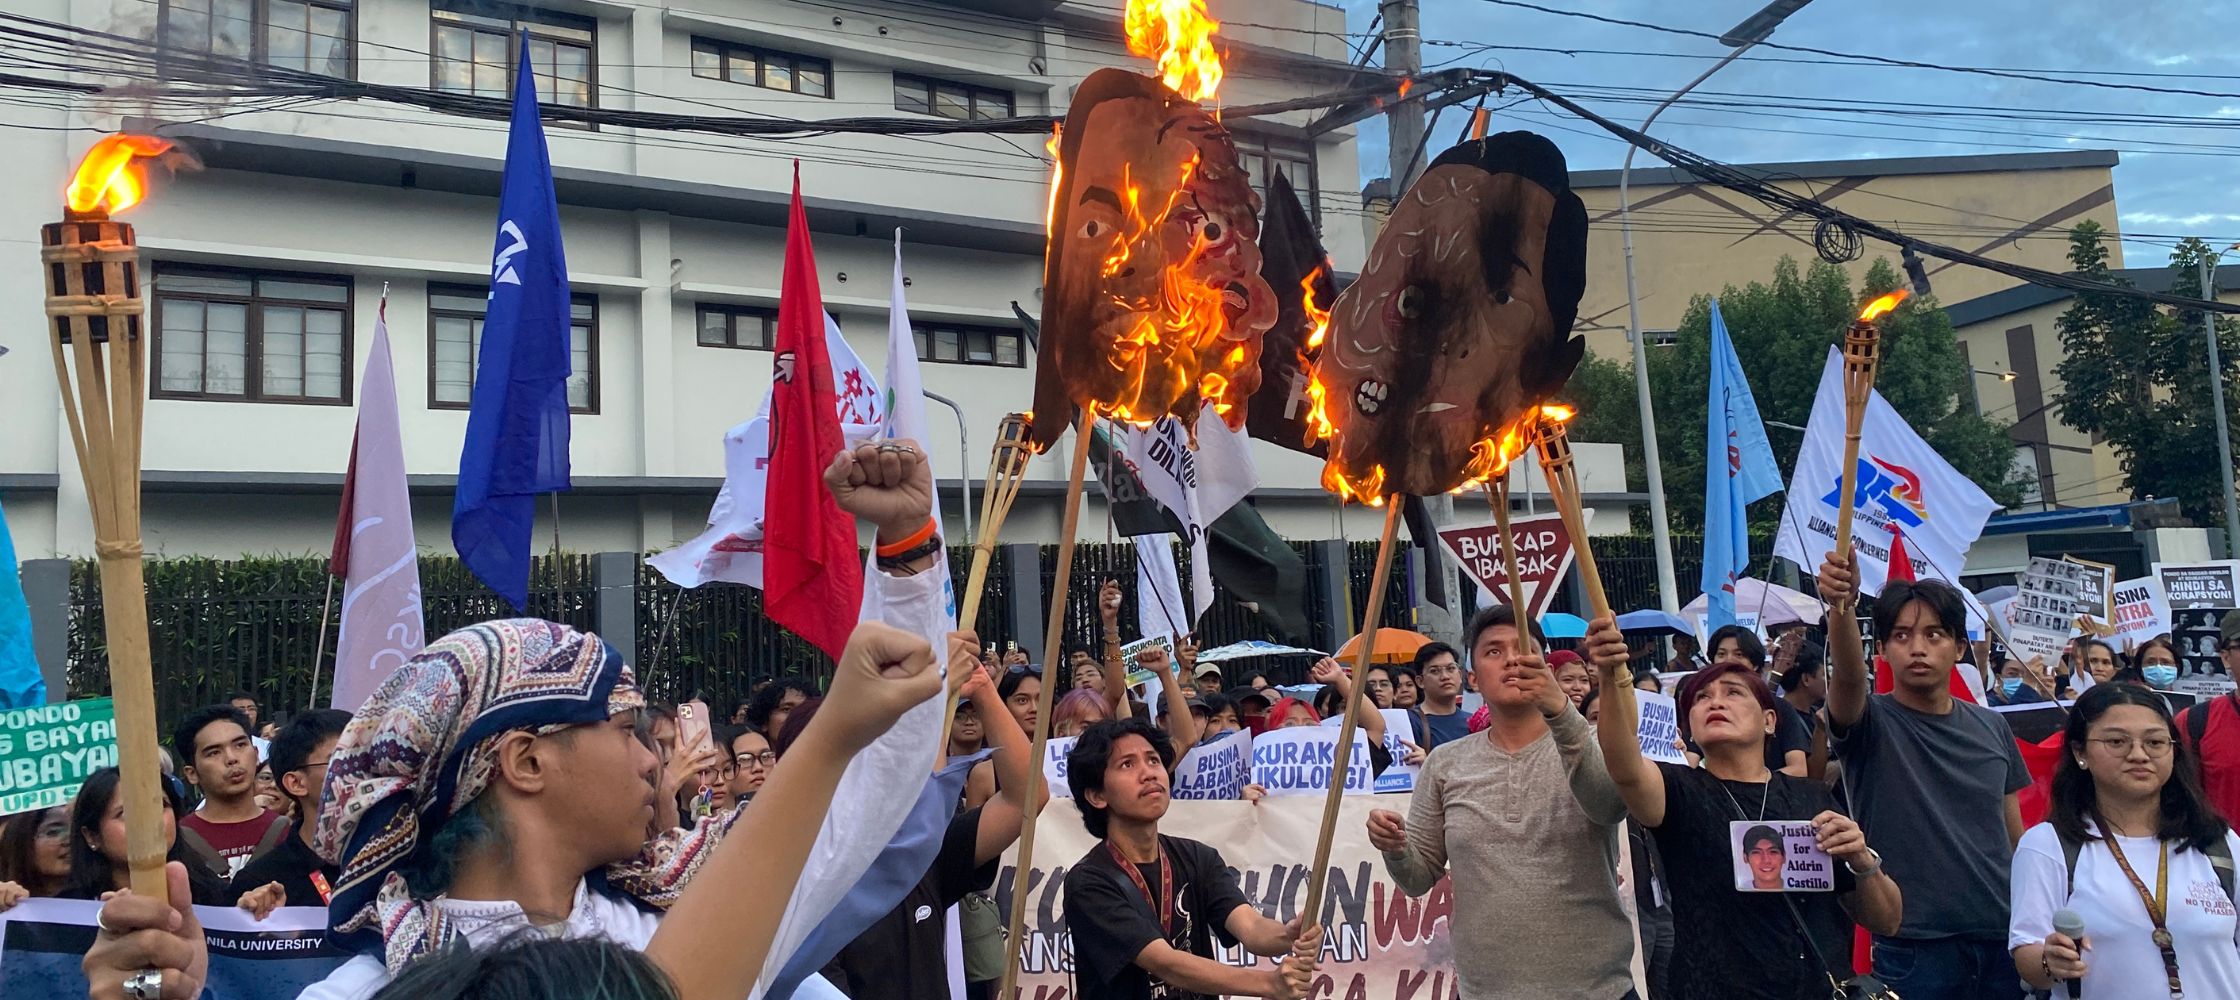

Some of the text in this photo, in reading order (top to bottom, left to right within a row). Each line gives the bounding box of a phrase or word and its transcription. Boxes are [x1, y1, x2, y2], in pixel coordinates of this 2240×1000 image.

[2085, 581, 2098, 593] SA
[2170, 580, 2226, 591] HINDI SA
[2113, 586, 2150, 606] SINA
[1642, 702, 1674, 724] BUSINA
[1665, 725, 1677, 741] SA
[1197, 744, 1240, 774] BUSINA
[1252, 741, 1370, 768] KURAKT,
[1181, 765, 1233, 790] LABAN
[3, 789, 57, 813] UPD
[1794, 843, 1810, 854] for
[1787, 860, 1823, 871] Aldrin
[1787, 877, 1829, 889] Castillo
[2185, 898, 2198, 906] NO
[240, 938, 322, 951] UNIVERSITY
